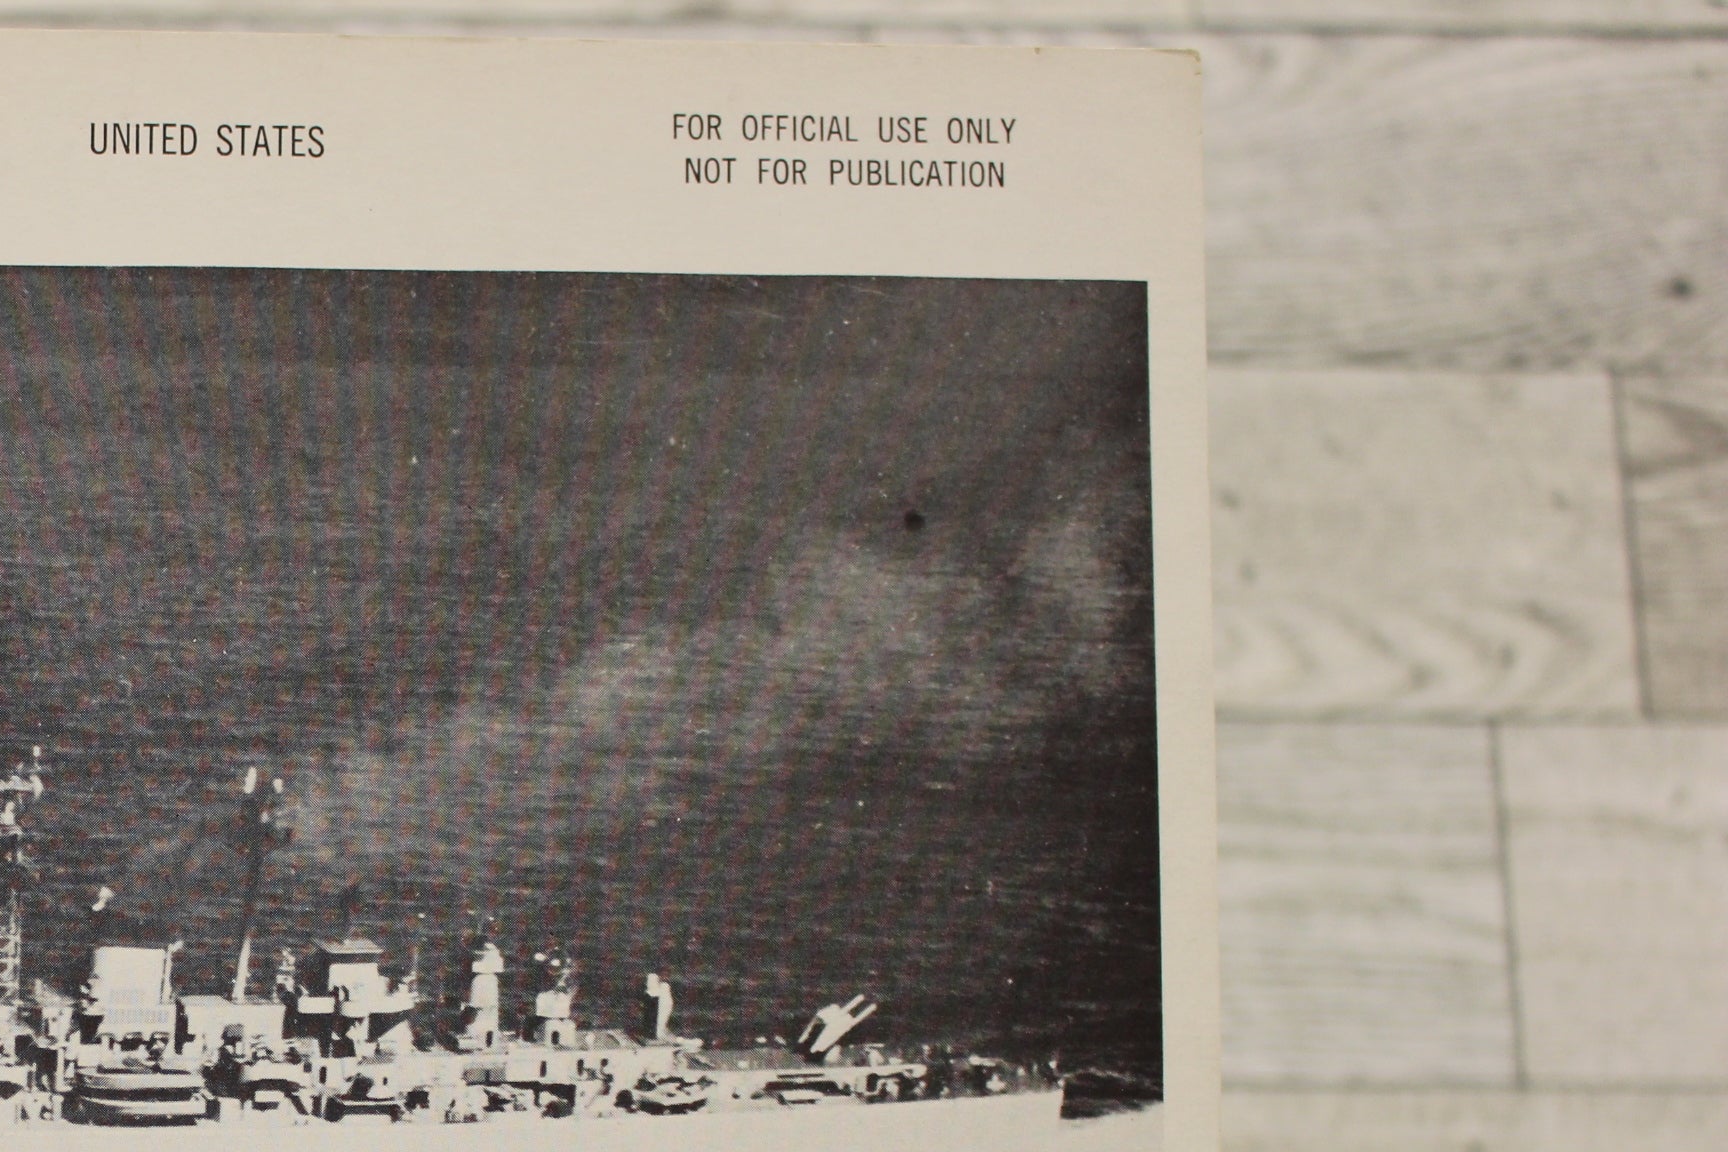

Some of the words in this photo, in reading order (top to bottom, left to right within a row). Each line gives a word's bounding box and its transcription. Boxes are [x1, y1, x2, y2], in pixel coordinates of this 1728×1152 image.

[90, 122, 198, 156] UNITED
[216, 123, 325, 159] STATES
[673, 113, 722, 141] FOR
[741, 114, 858, 142] OFFICIAL
[878, 116, 928, 144] USE
[947, 117, 1017, 144] ONLY
[685, 157, 737, 184] NOT
[758, 158, 807, 185] FOR
[829, 159, 1005, 188] PUBLICATION
